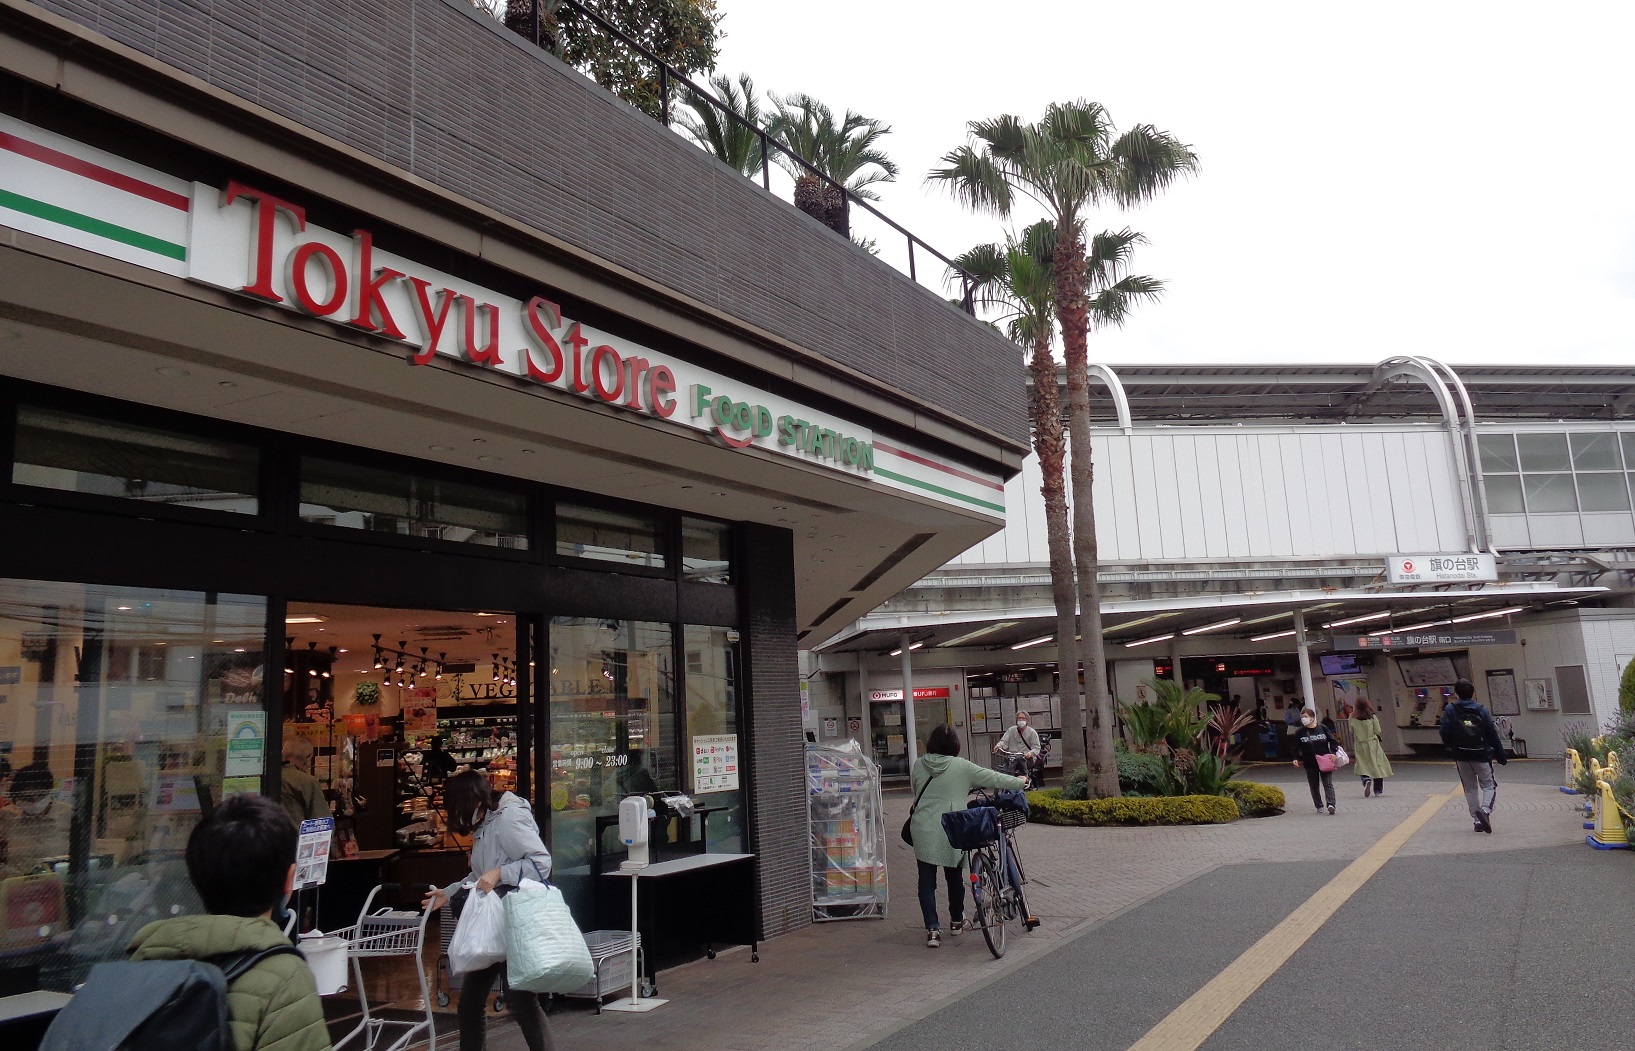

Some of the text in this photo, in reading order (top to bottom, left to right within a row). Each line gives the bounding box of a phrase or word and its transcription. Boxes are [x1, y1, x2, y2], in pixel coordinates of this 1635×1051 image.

[221, 180, 677, 418] Tokyu Store
[690, 384, 874, 470] FOOD STATION
[1429, 557, 1480, 572] 旗の台駅
[1406, 635, 1437, 645] 旗の台駅
[570, 750, 584, 758] open
[575, 757, 594, 769] 9:00
[605, 755, 628, 767] 23:00
